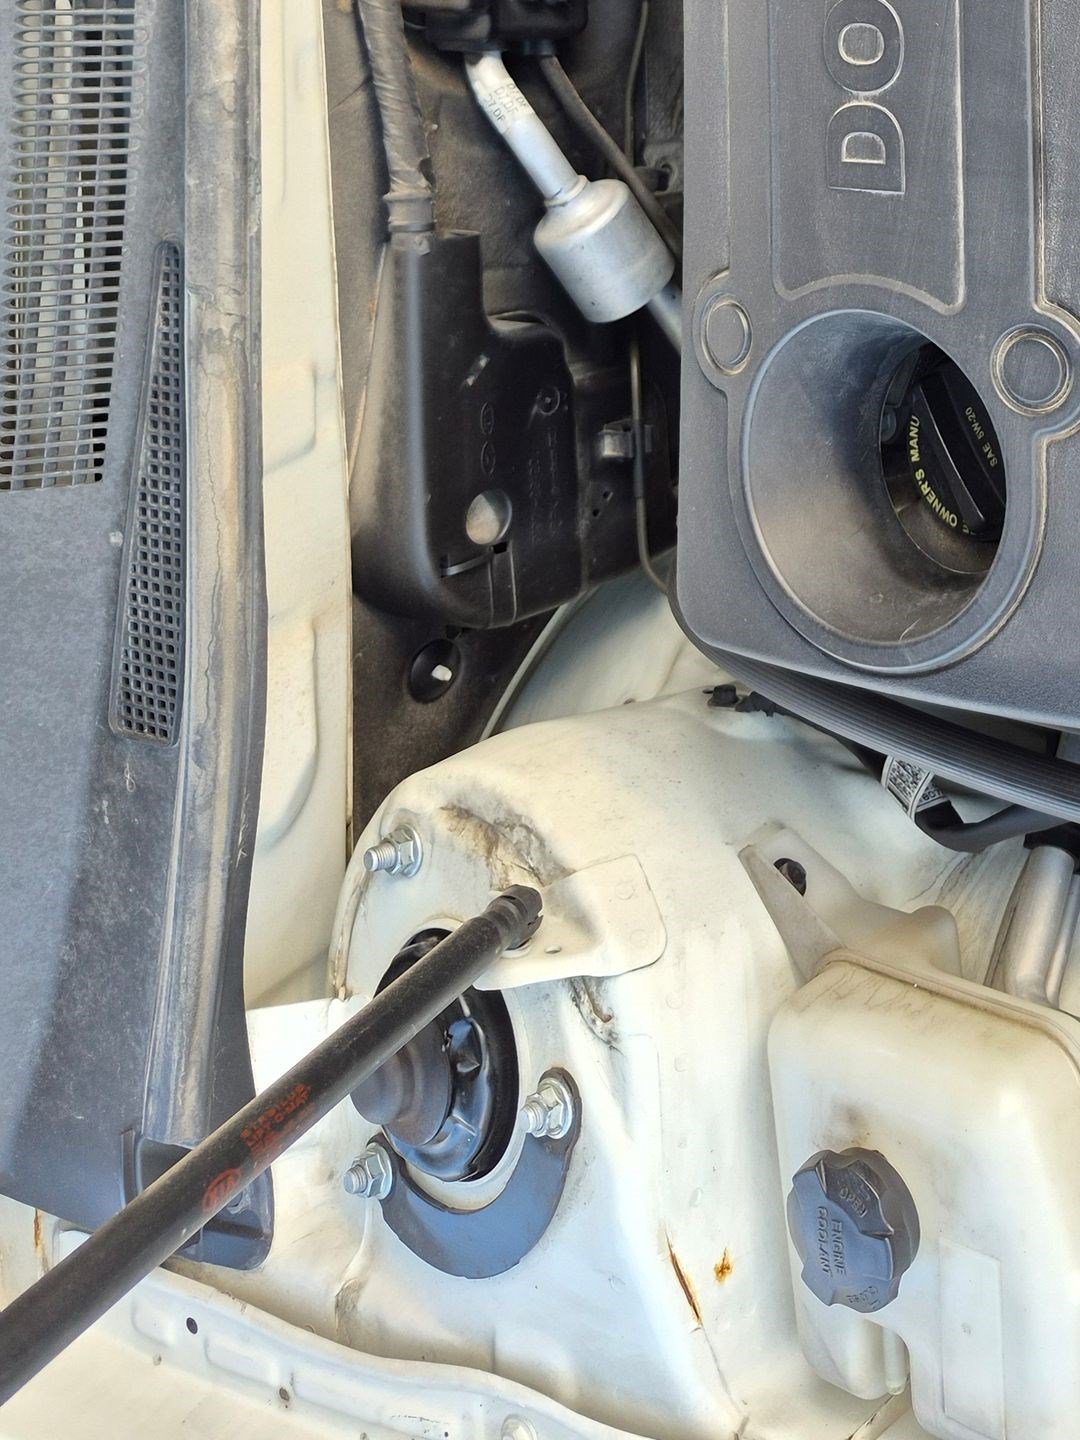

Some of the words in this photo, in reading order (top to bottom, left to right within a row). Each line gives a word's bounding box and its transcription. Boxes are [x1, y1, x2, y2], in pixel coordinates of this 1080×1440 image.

[964, 406, 985, 440] 5W-20
[982, 441, 998, 468] SAE
[915, 468, 958, 527] OWNER'S
[839, 1187, 869, 1218] OPEN
[815, 1205, 833, 1278] COOLANT
[831, 1218, 847, 1276] ENGINE
